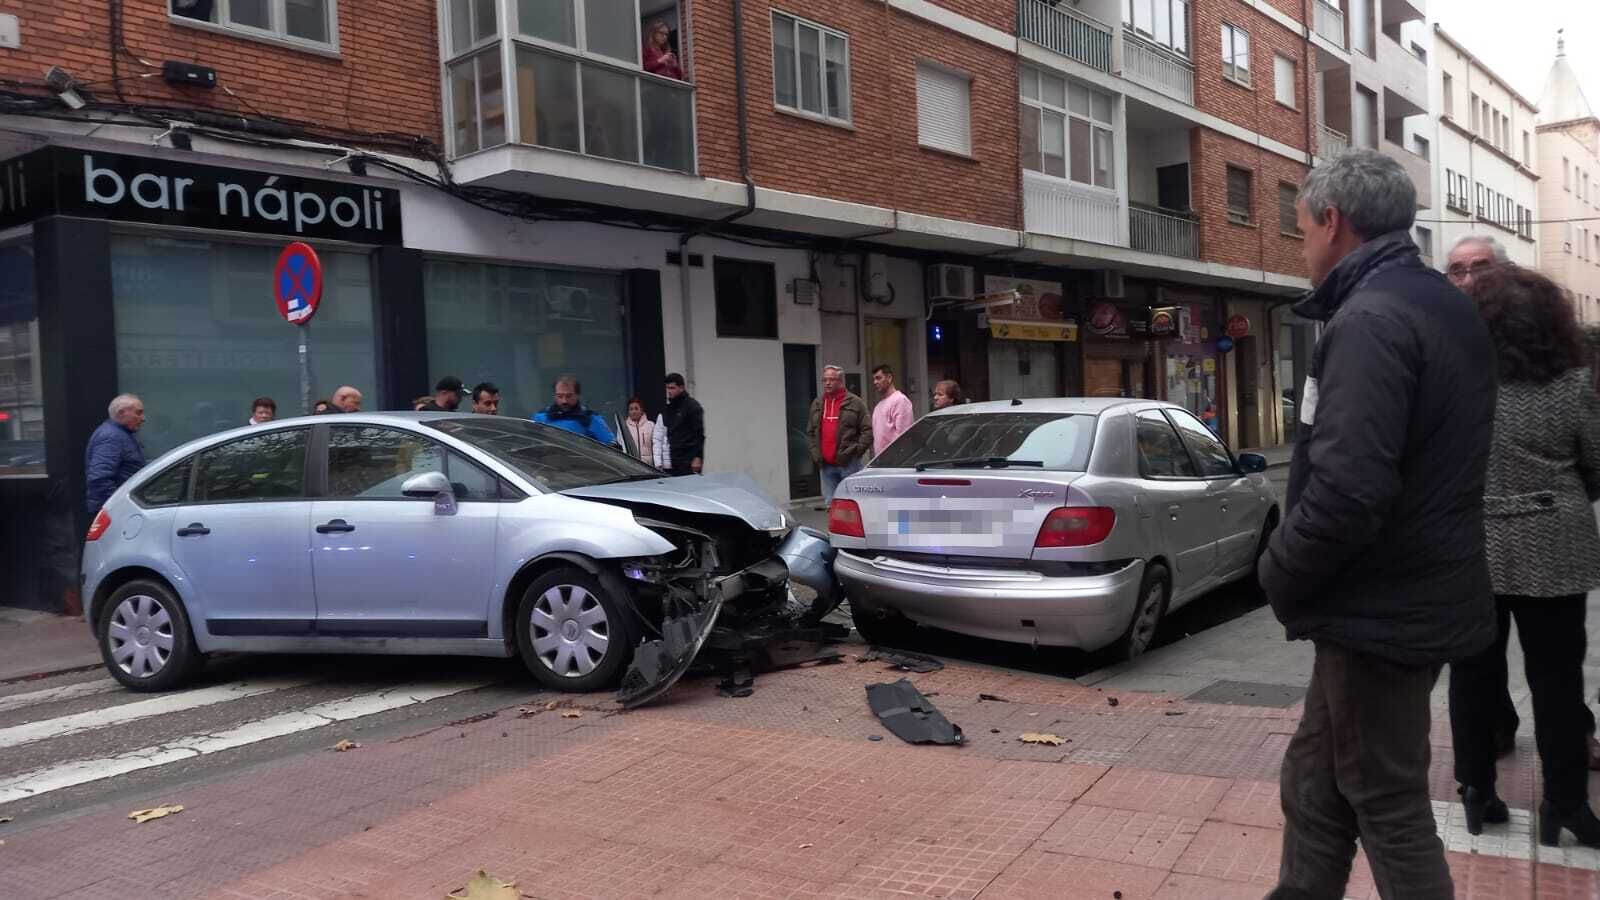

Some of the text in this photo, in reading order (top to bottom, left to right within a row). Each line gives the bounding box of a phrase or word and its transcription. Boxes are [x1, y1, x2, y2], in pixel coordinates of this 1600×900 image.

[0, 160, 27, 212] li
[84, 155, 384, 233] bar nápoli
